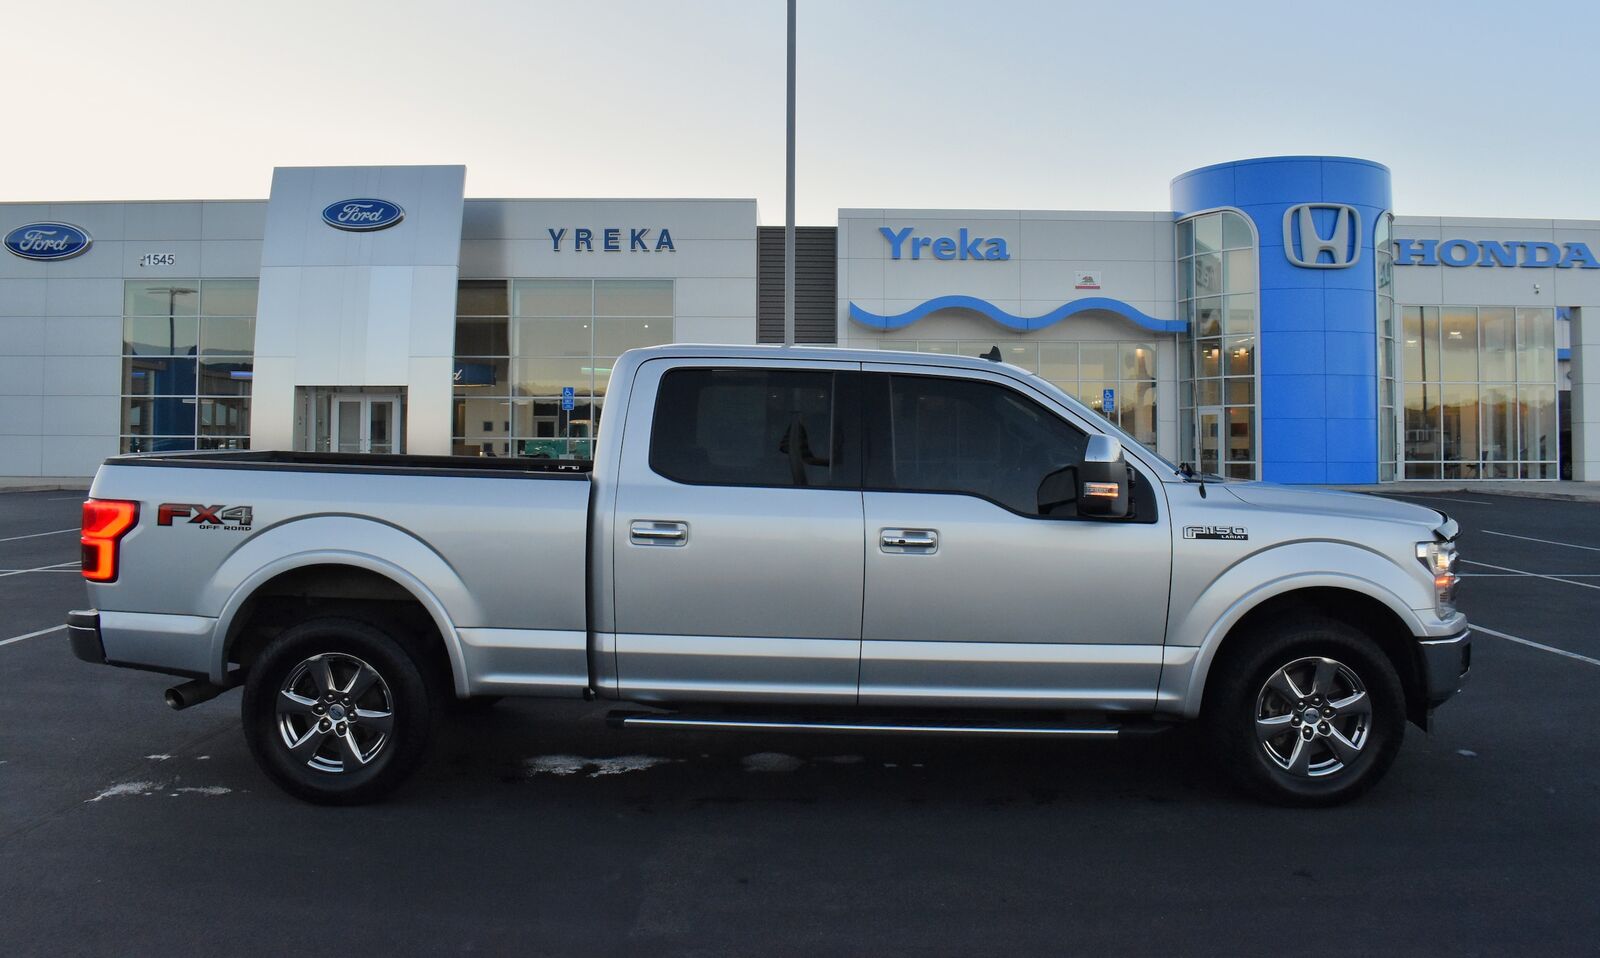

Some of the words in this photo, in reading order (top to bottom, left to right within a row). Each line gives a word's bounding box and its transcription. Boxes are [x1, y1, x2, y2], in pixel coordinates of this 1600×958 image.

[338, 203, 384, 221] Ford
[20, 230, 69, 251] Ford
[548, 228, 676, 252] YREKA
[879, 227, 1010, 260] Yreka
[146, 254, 175, 265] 1545
[1393, 239, 1600, 269] HONDA
[157, 503, 253, 526] FX4
